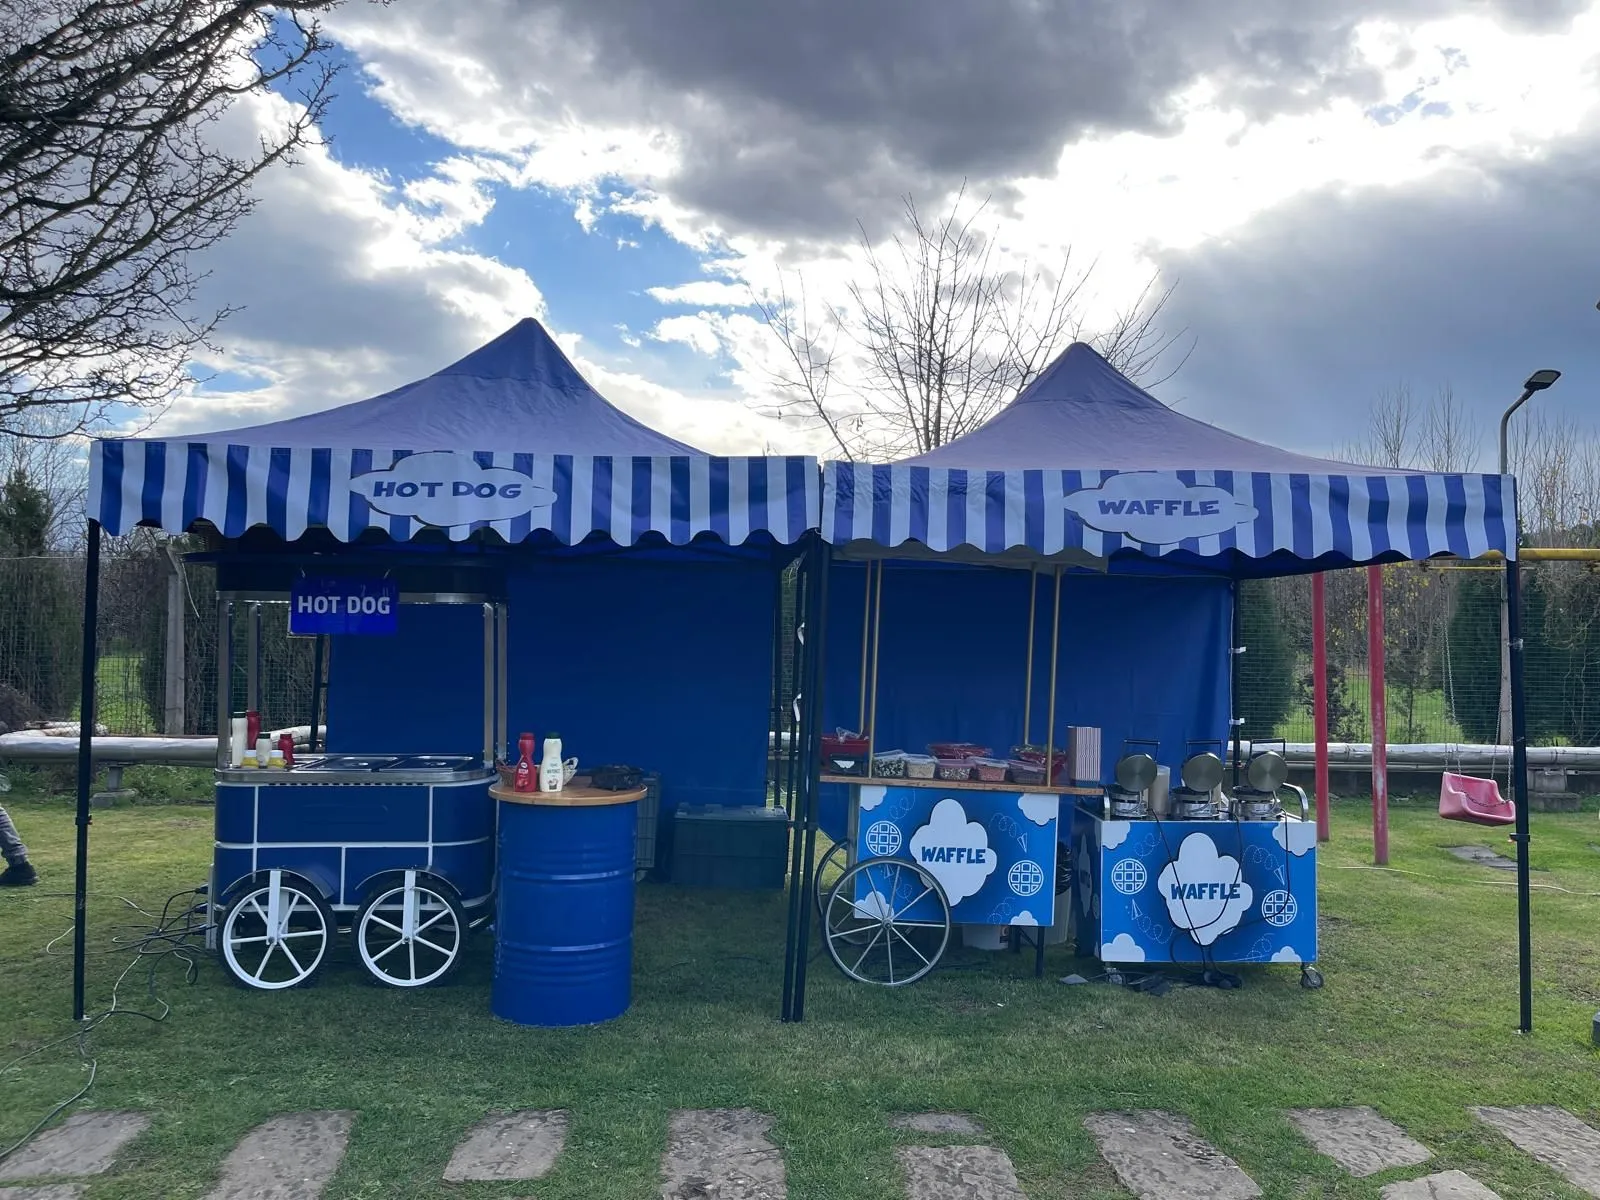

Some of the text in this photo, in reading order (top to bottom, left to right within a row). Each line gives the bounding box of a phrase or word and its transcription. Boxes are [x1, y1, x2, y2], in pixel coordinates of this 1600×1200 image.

[373, 481, 523, 499] HOT DOG
[1098, 500, 1220, 517] WAFFLE
[298, 595, 390, 615] HOT DOG
[921, 846, 986, 864] WAFFLE
[1170, 882, 1241, 900] WAFFLE
